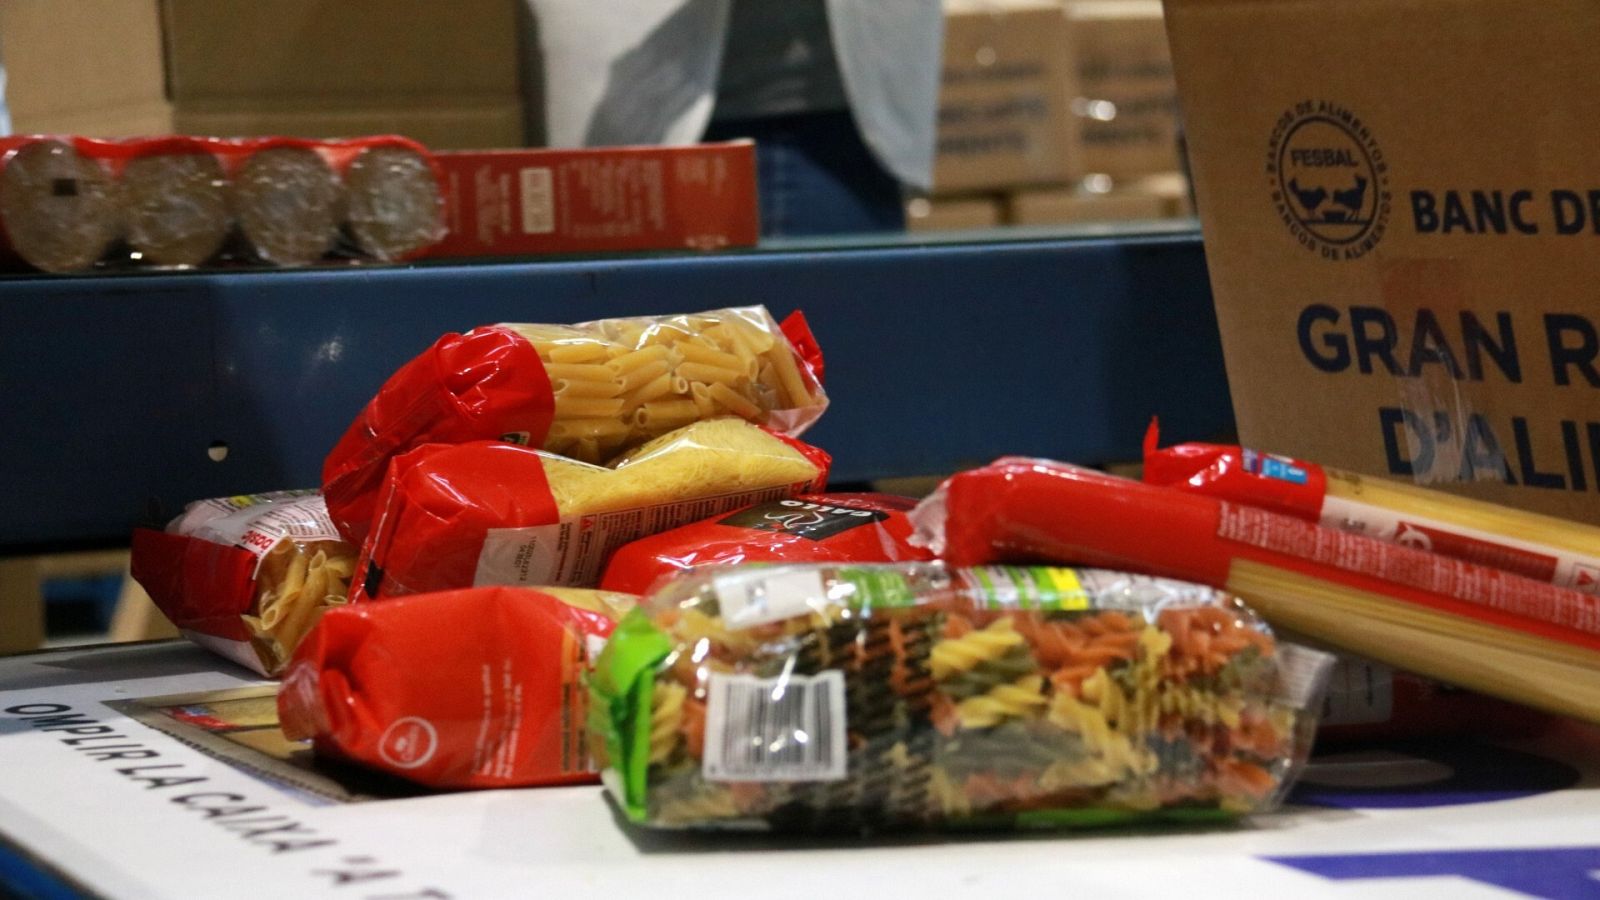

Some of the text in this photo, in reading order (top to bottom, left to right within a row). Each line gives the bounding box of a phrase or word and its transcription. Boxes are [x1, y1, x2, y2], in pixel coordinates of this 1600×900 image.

[1290, 149, 1359, 167] FESBAL
[1410, 189, 1540, 235] BANC
[1297, 303, 1523, 384] GRAN
[1378, 406, 1600, 493] D'ALI
[780, 500, 873, 518] GALLO
[4, 703, 161, 762] OMPLIR
[115, 764, 211, 791] LA
[170, 792, 338, 854] CAIXA
